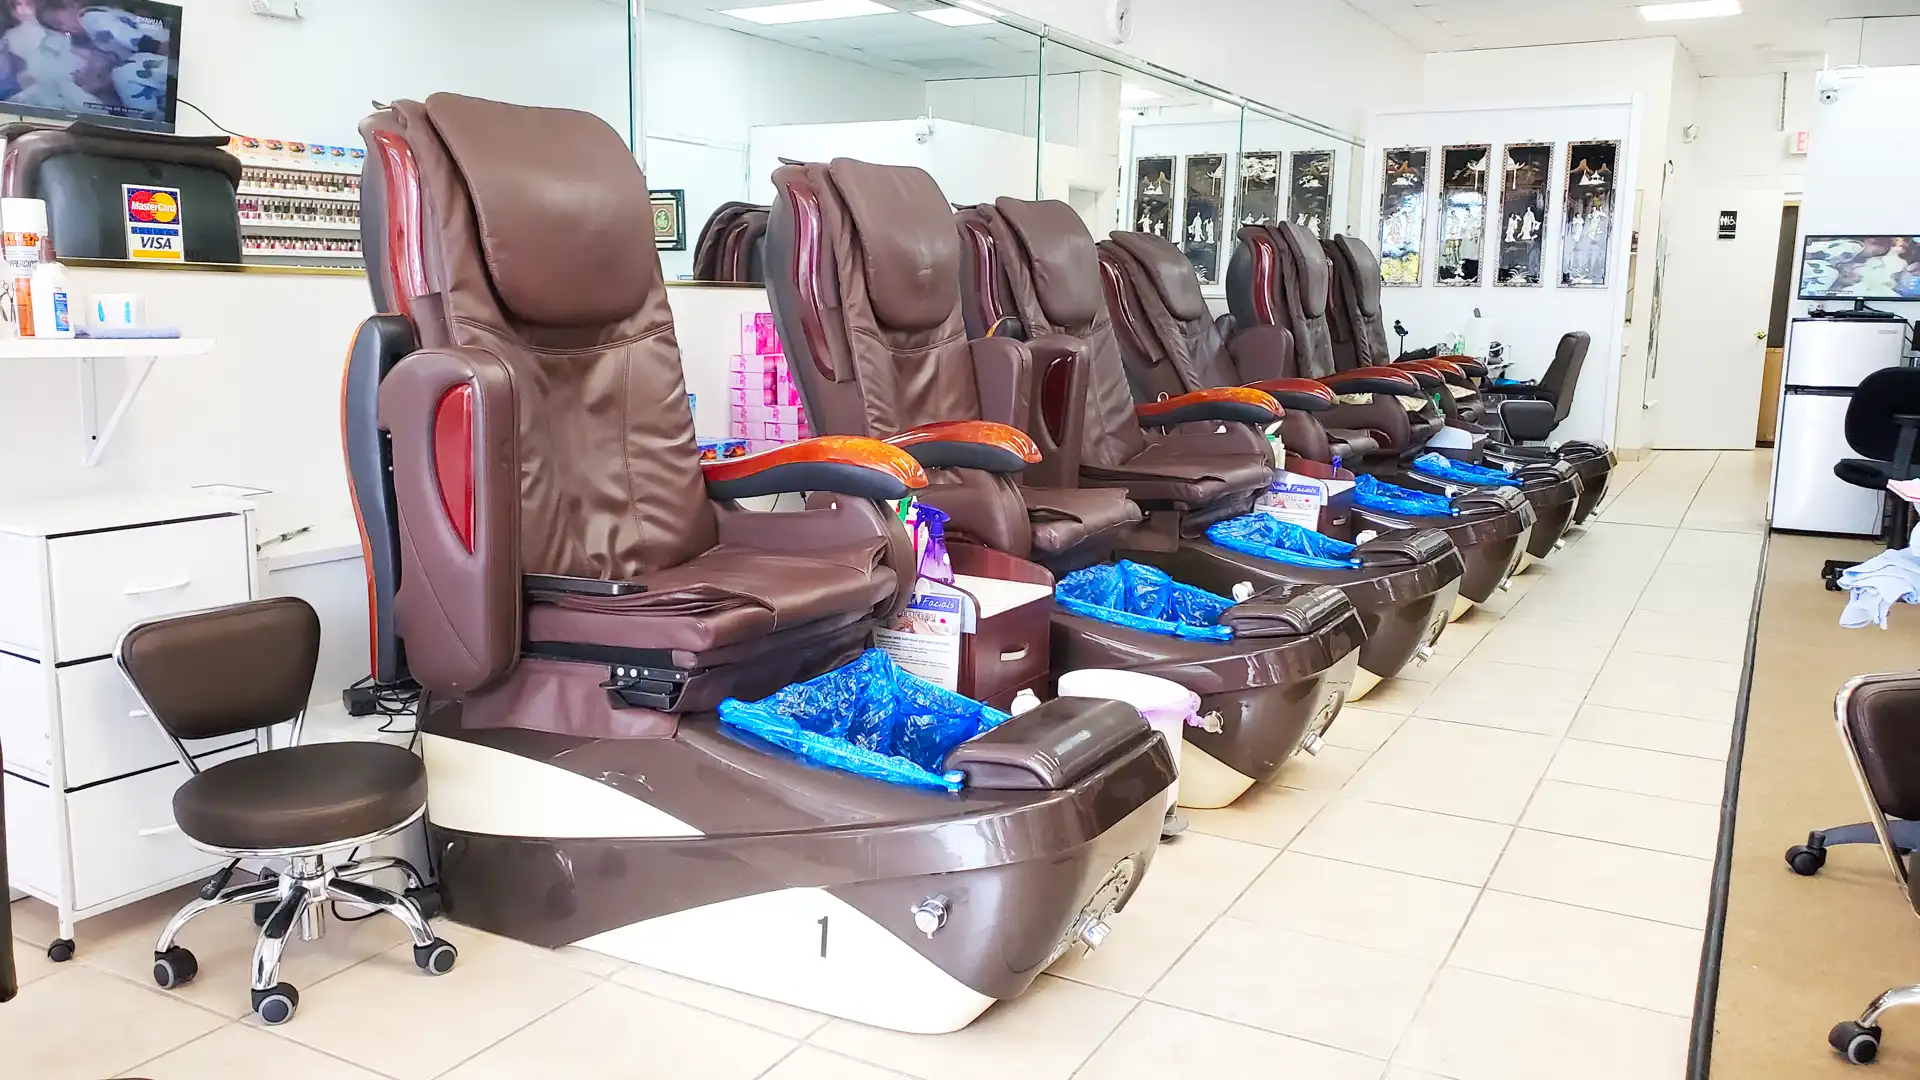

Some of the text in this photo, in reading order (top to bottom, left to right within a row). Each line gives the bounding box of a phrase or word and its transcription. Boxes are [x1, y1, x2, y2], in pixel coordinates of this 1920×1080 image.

[131, 201, 176, 213] MasterCard
[140, 236, 172, 250] VISA
[922, 597, 955, 609] Facials
[817, 915, 828, 958] 1
